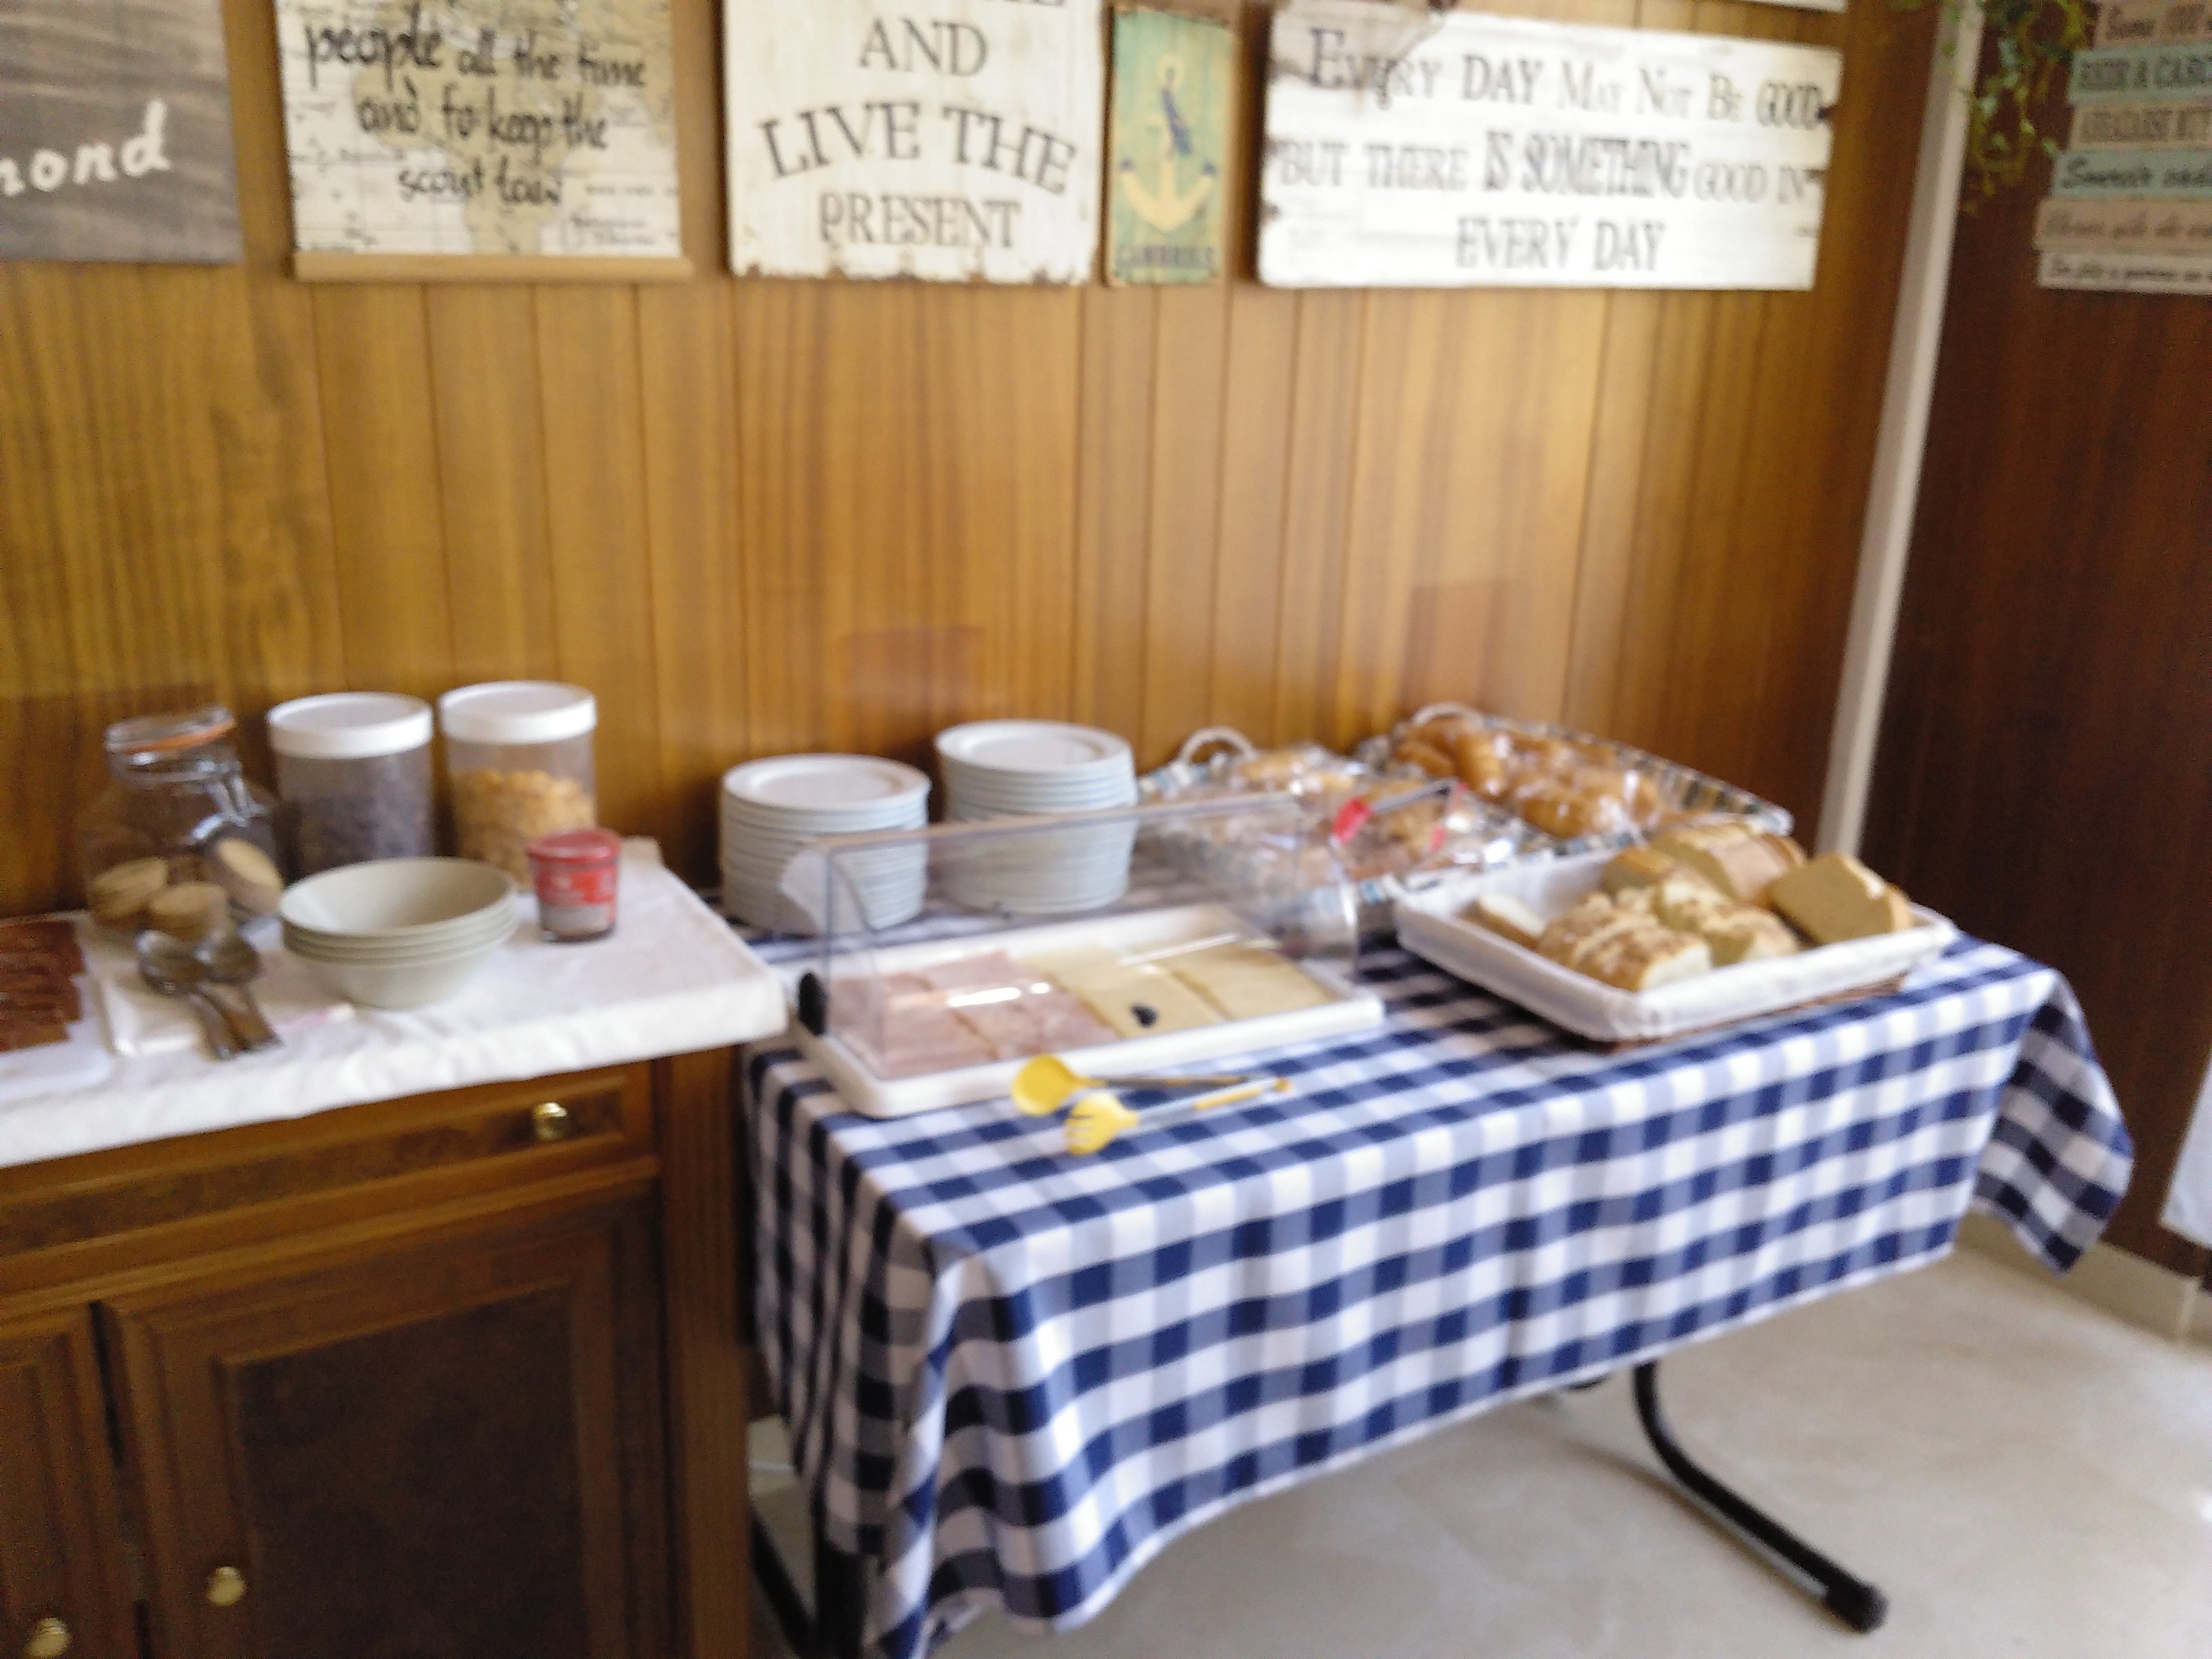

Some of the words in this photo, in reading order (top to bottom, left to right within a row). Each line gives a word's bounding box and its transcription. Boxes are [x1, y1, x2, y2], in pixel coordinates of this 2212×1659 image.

[306, 1, 444, 91] people
[457, 28, 496, 76] all
[515, 28, 560, 80] the
[577, 39, 647, 87] time
[858, 18, 988, 77] AND
[356, 77, 420, 134] and
[562, 91, 607, 149] the
[1460, 53, 1544, 104] DAY
[1755, 82, 1824, 130] GOOD
[398, 158, 484, 200] scout
[758, 100, 922, 179] LIVE
[943, 106, 1078, 195] THE
[1279, 139, 1348, 186] BUT
[1365, 143, 1469, 192] THERE
[1482, 130, 1514, 192] IS
[1521, 131, 1689, 198] SOMETHING
[1694, 163, 1768, 203] GOOD
[818, 192, 1023, 249] PRESENT
[1456, 216, 1580, 269] EVERY
[1593, 218, 1666, 271] DAY
